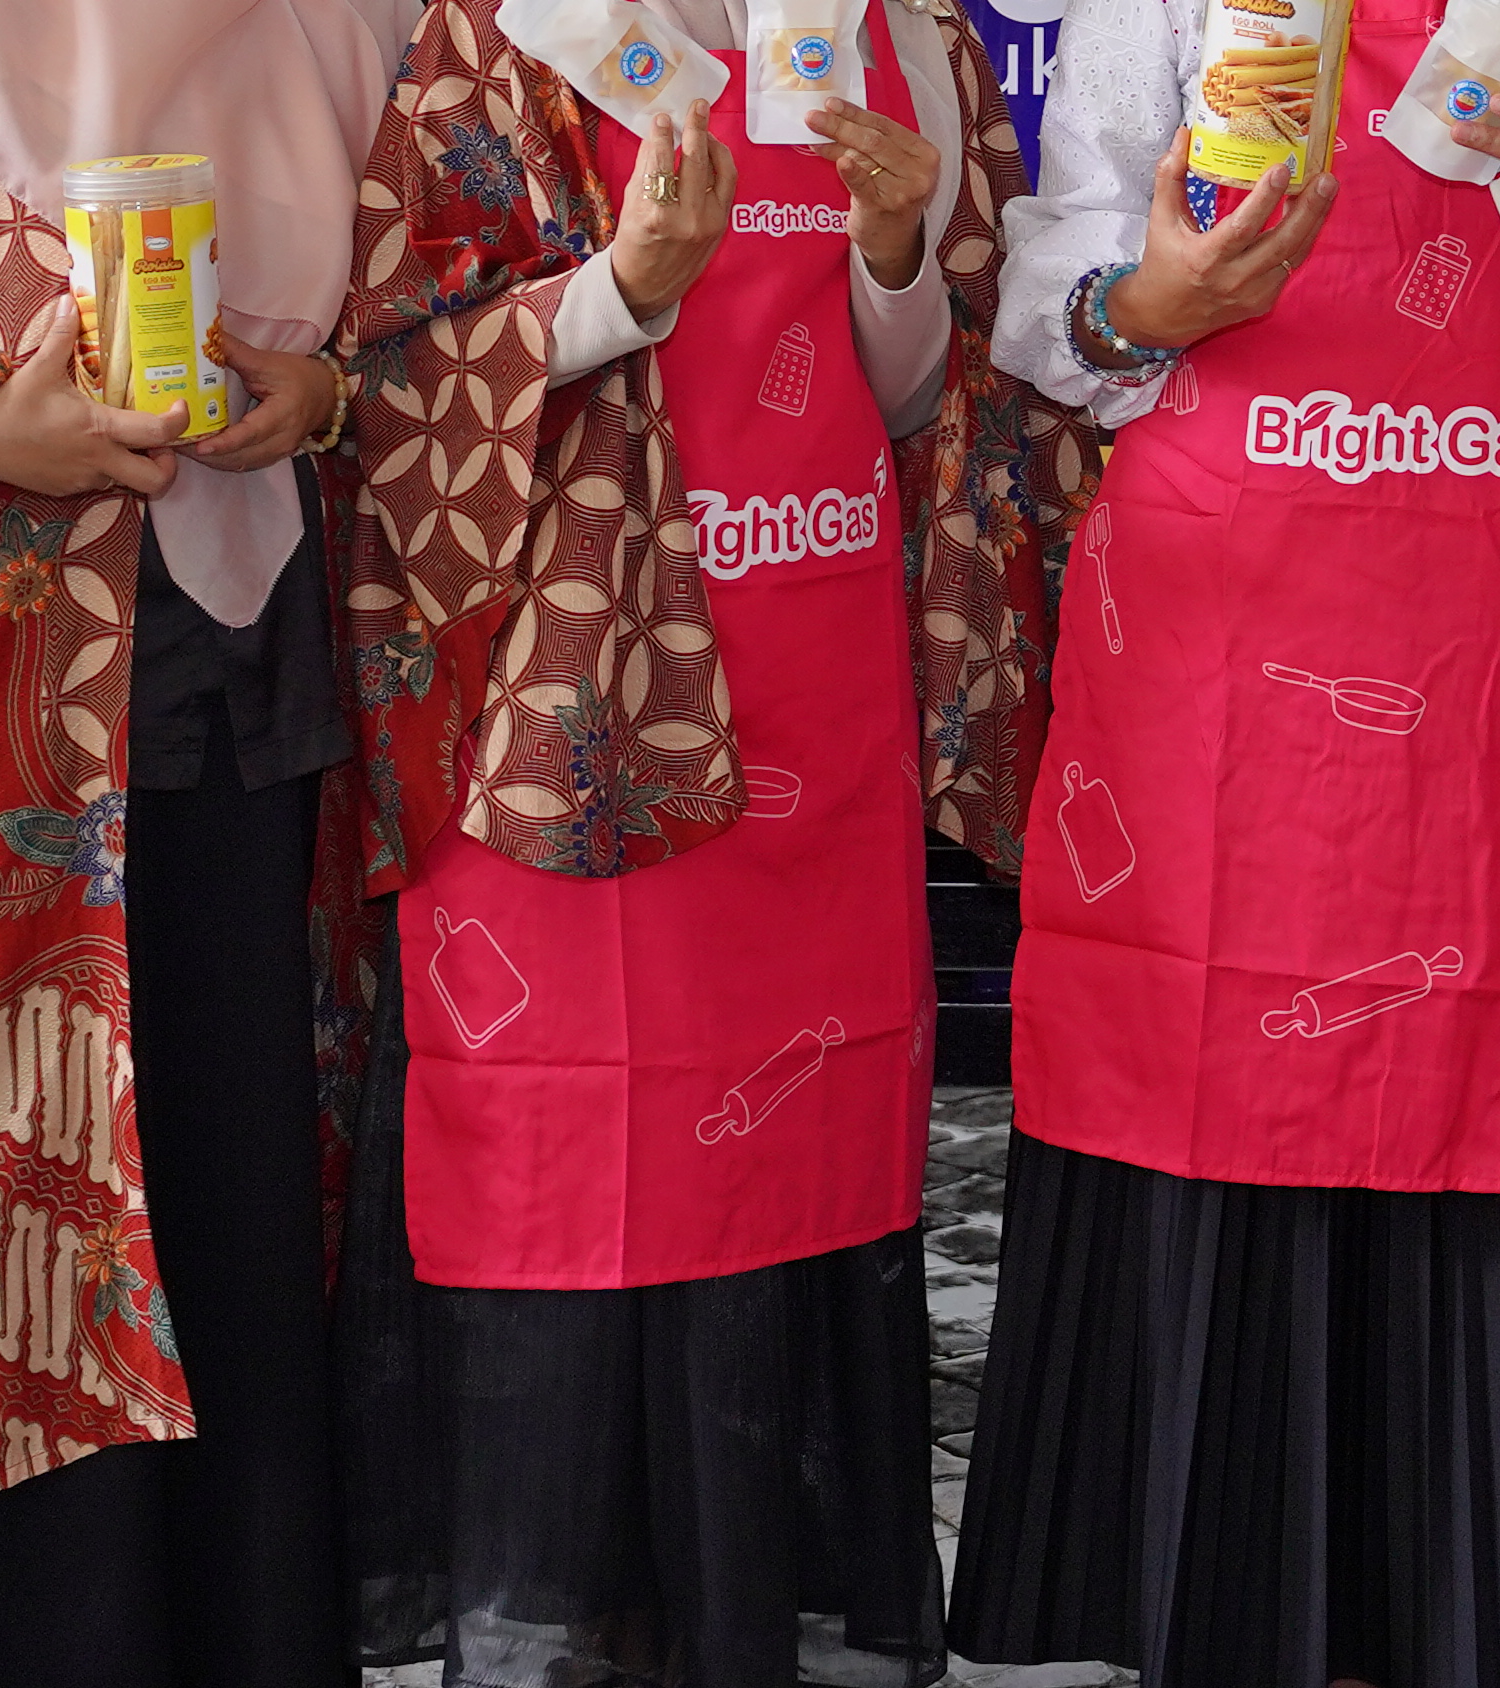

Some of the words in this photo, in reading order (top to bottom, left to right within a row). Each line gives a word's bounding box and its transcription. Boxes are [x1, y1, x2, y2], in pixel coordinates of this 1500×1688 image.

[1253, 19, 1275, 31] ROLL
[736, 204, 809, 233] Bright
[1253, 400, 1431, 474] Bright
[690, 498, 801, 568] ight
[810, 496, 876, 549] Gas
